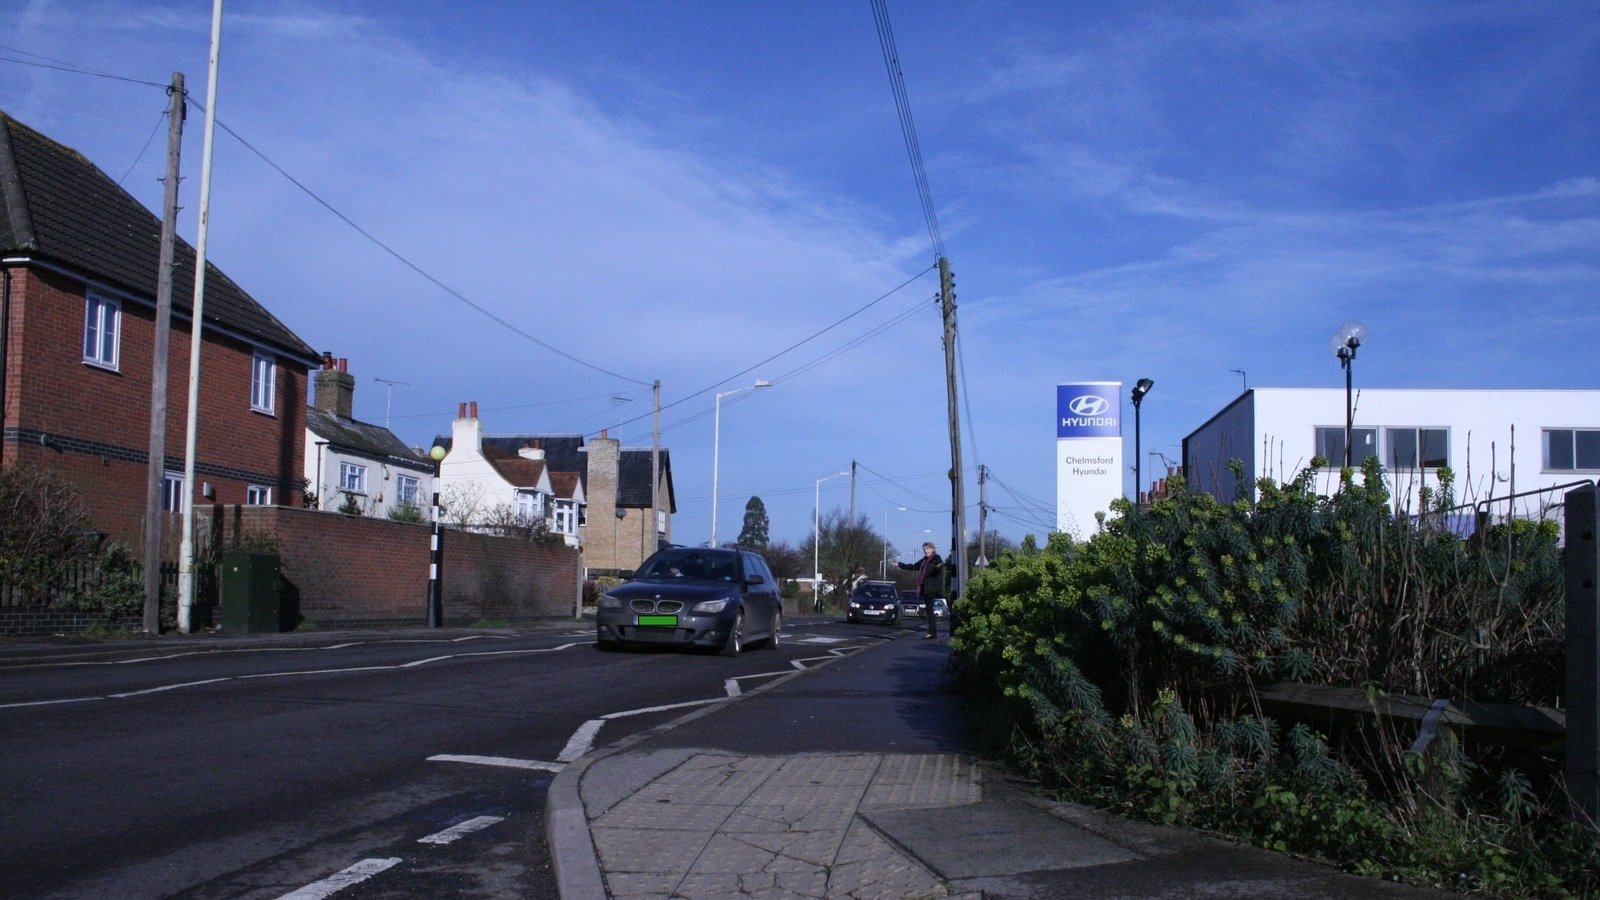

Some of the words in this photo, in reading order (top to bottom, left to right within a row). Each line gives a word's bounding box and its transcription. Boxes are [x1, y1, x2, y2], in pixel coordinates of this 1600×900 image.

[1062, 417, 1116, 427] HYUNDAI
[1065, 456, 1114, 465] Chelmsford
[1072, 467, 1107, 476] Hyundai
